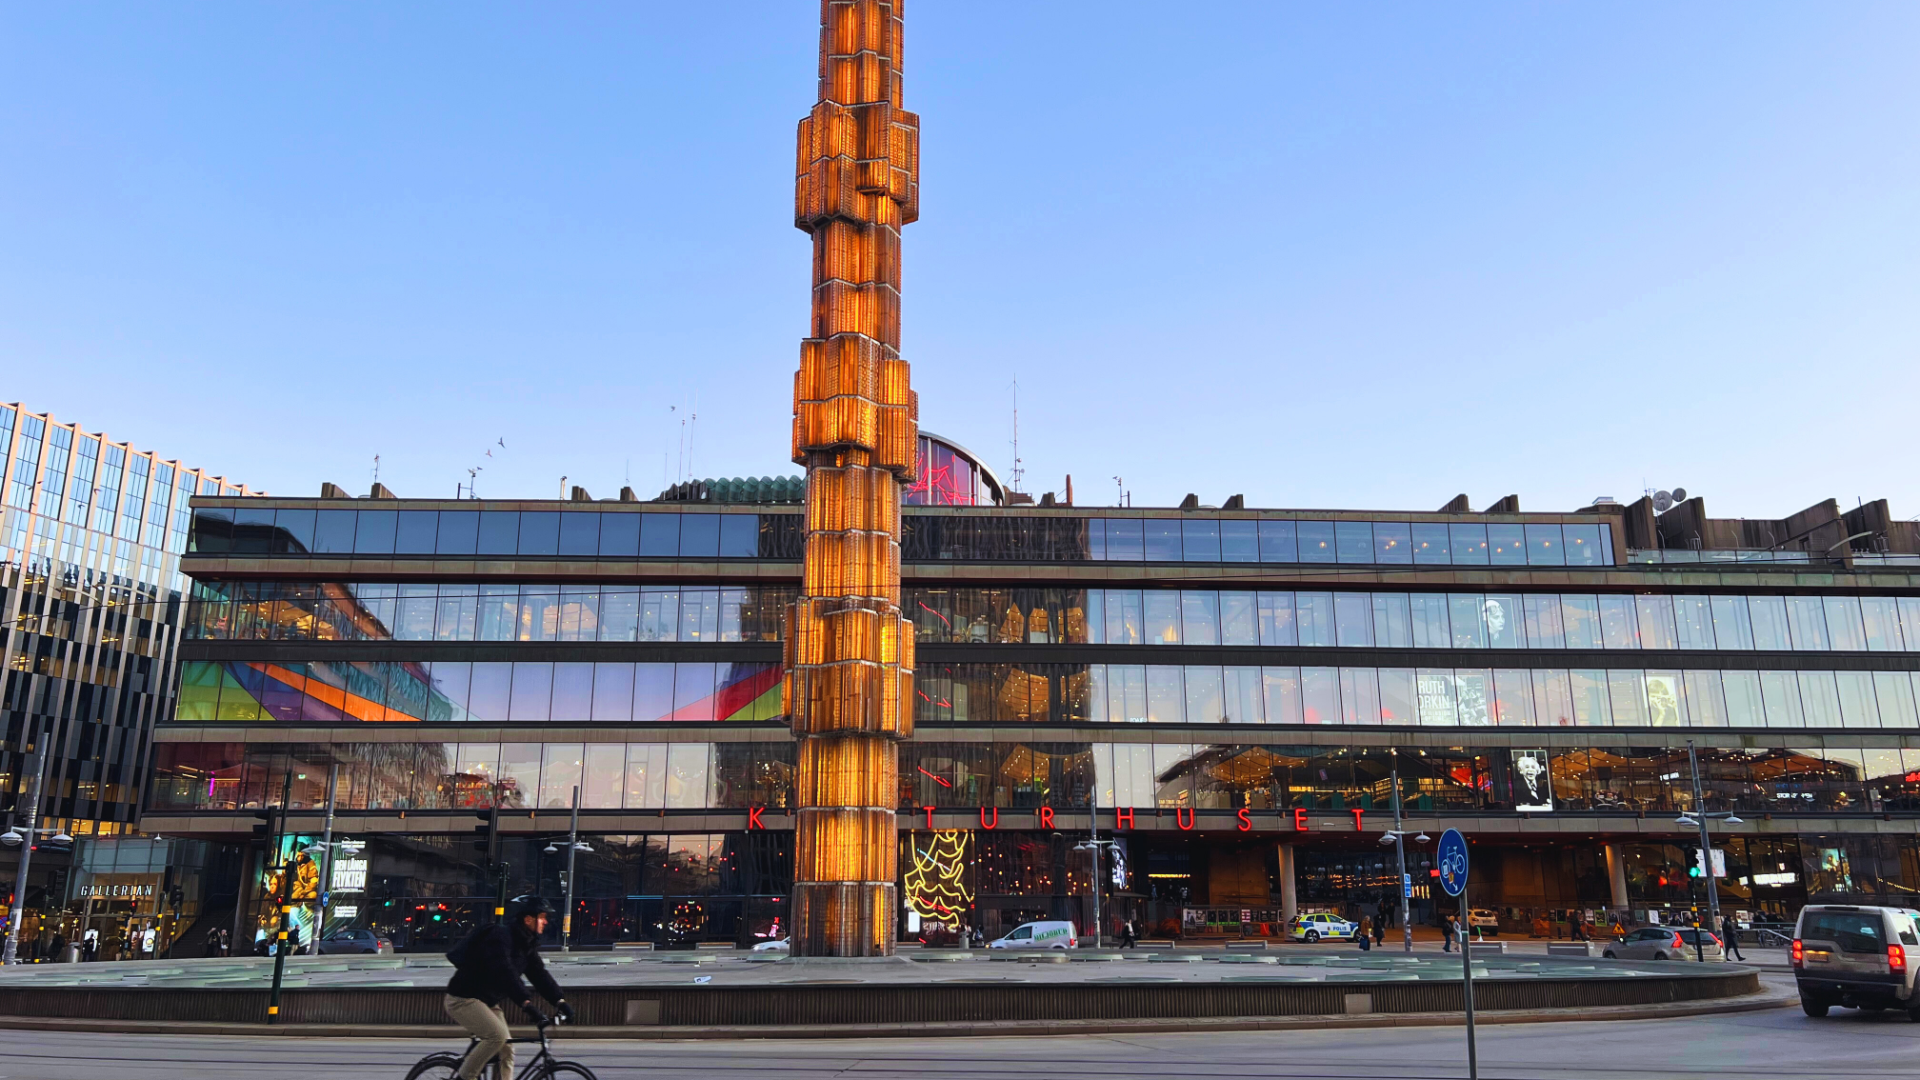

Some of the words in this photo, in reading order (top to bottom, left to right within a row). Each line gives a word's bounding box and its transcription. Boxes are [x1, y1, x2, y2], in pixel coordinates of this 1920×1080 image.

[1418, 680, 1446, 694] RUTH
[1416, 695, 1451, 709] ORKIN
[332, 871, 366, 888] FLYKTEN
[80, 885, 153, 896] GALLERIAN
